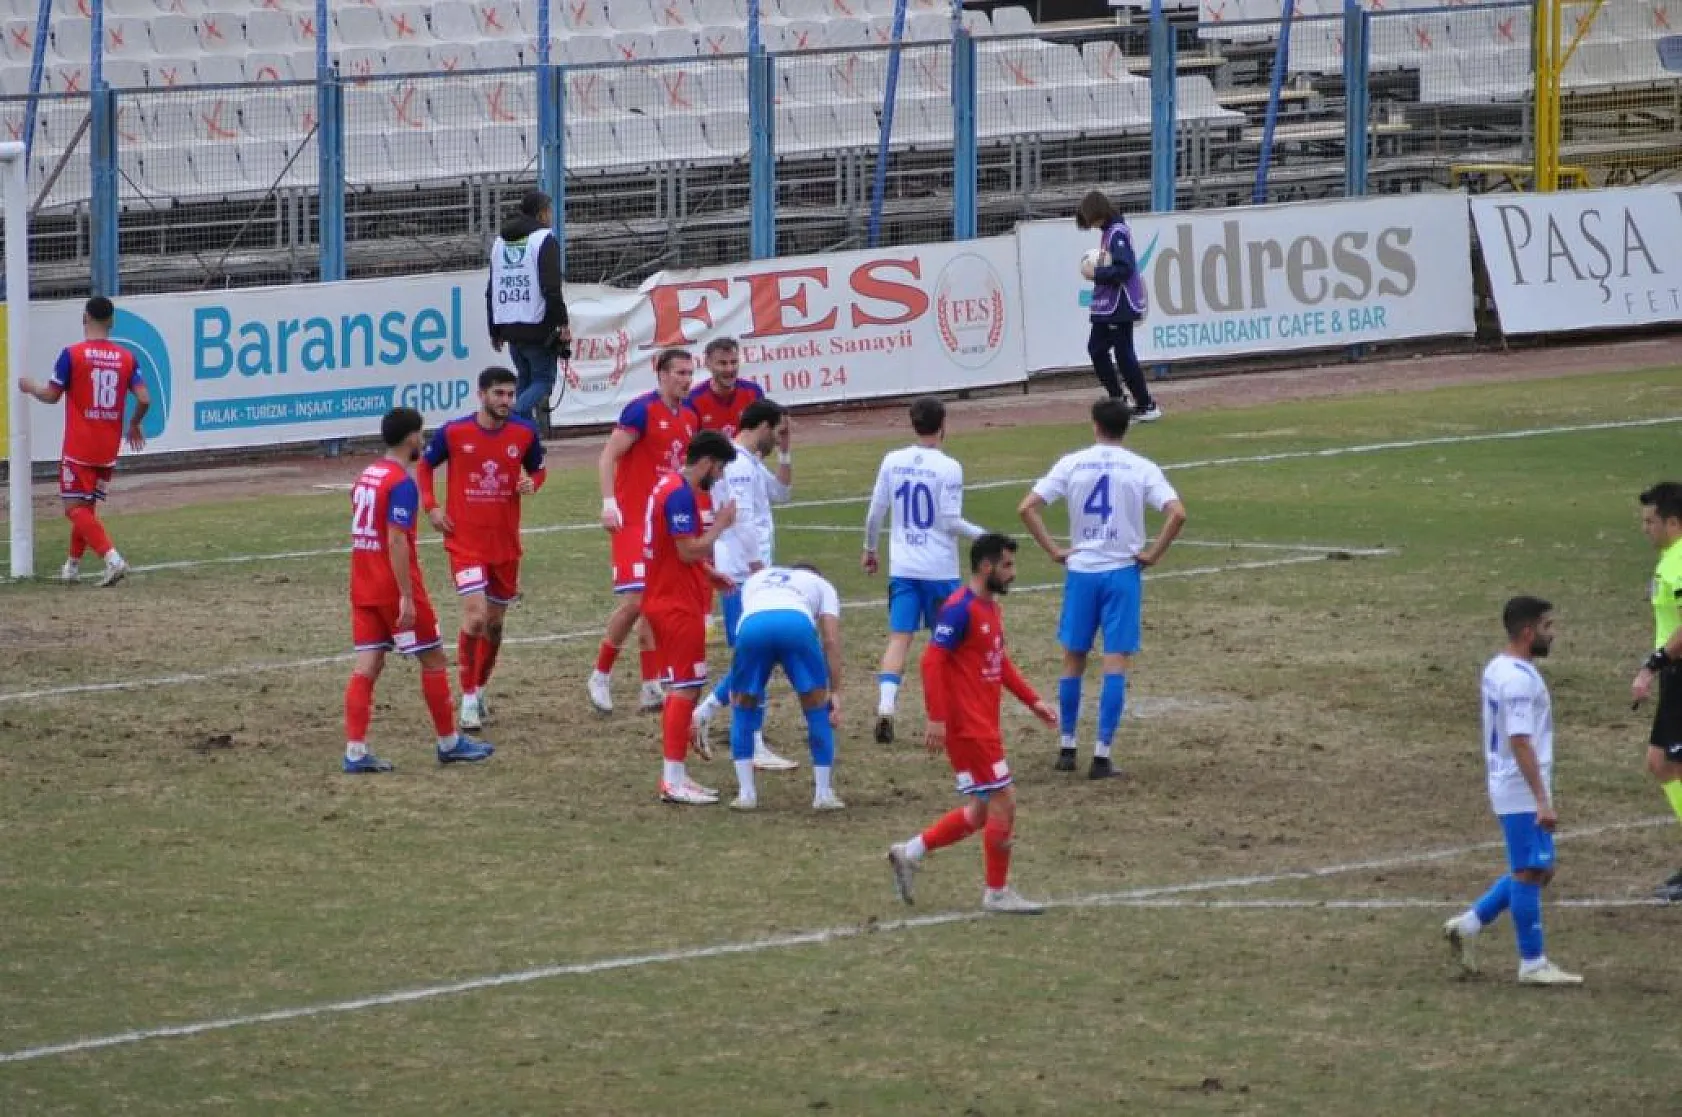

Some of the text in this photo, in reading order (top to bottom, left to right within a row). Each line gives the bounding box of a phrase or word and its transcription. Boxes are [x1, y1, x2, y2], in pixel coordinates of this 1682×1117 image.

[1137, 220, 1416, 316] ddress
[1493, 204, 1665, 304] PAŞA
[638, 256, 929, 350] FES
[951, 298, 990, 324] FES
[194, 286, 470, 380] Baransel
[743, 329, 913, 364] Ekmek Sanayii
[1153, 305, 1387, 350] RESTAURANT CAFE & BAR
[91, 368, 118, 408] 18
[401, 380, 470, 413] GRUP
[783, 369, 812, 390] 00
[820, 365, 847, 387] 24
[201, 407, 238, 425] EMLAK
[894, 480, 935, 530] 10
[1083, 474, 1112, 525] 4
